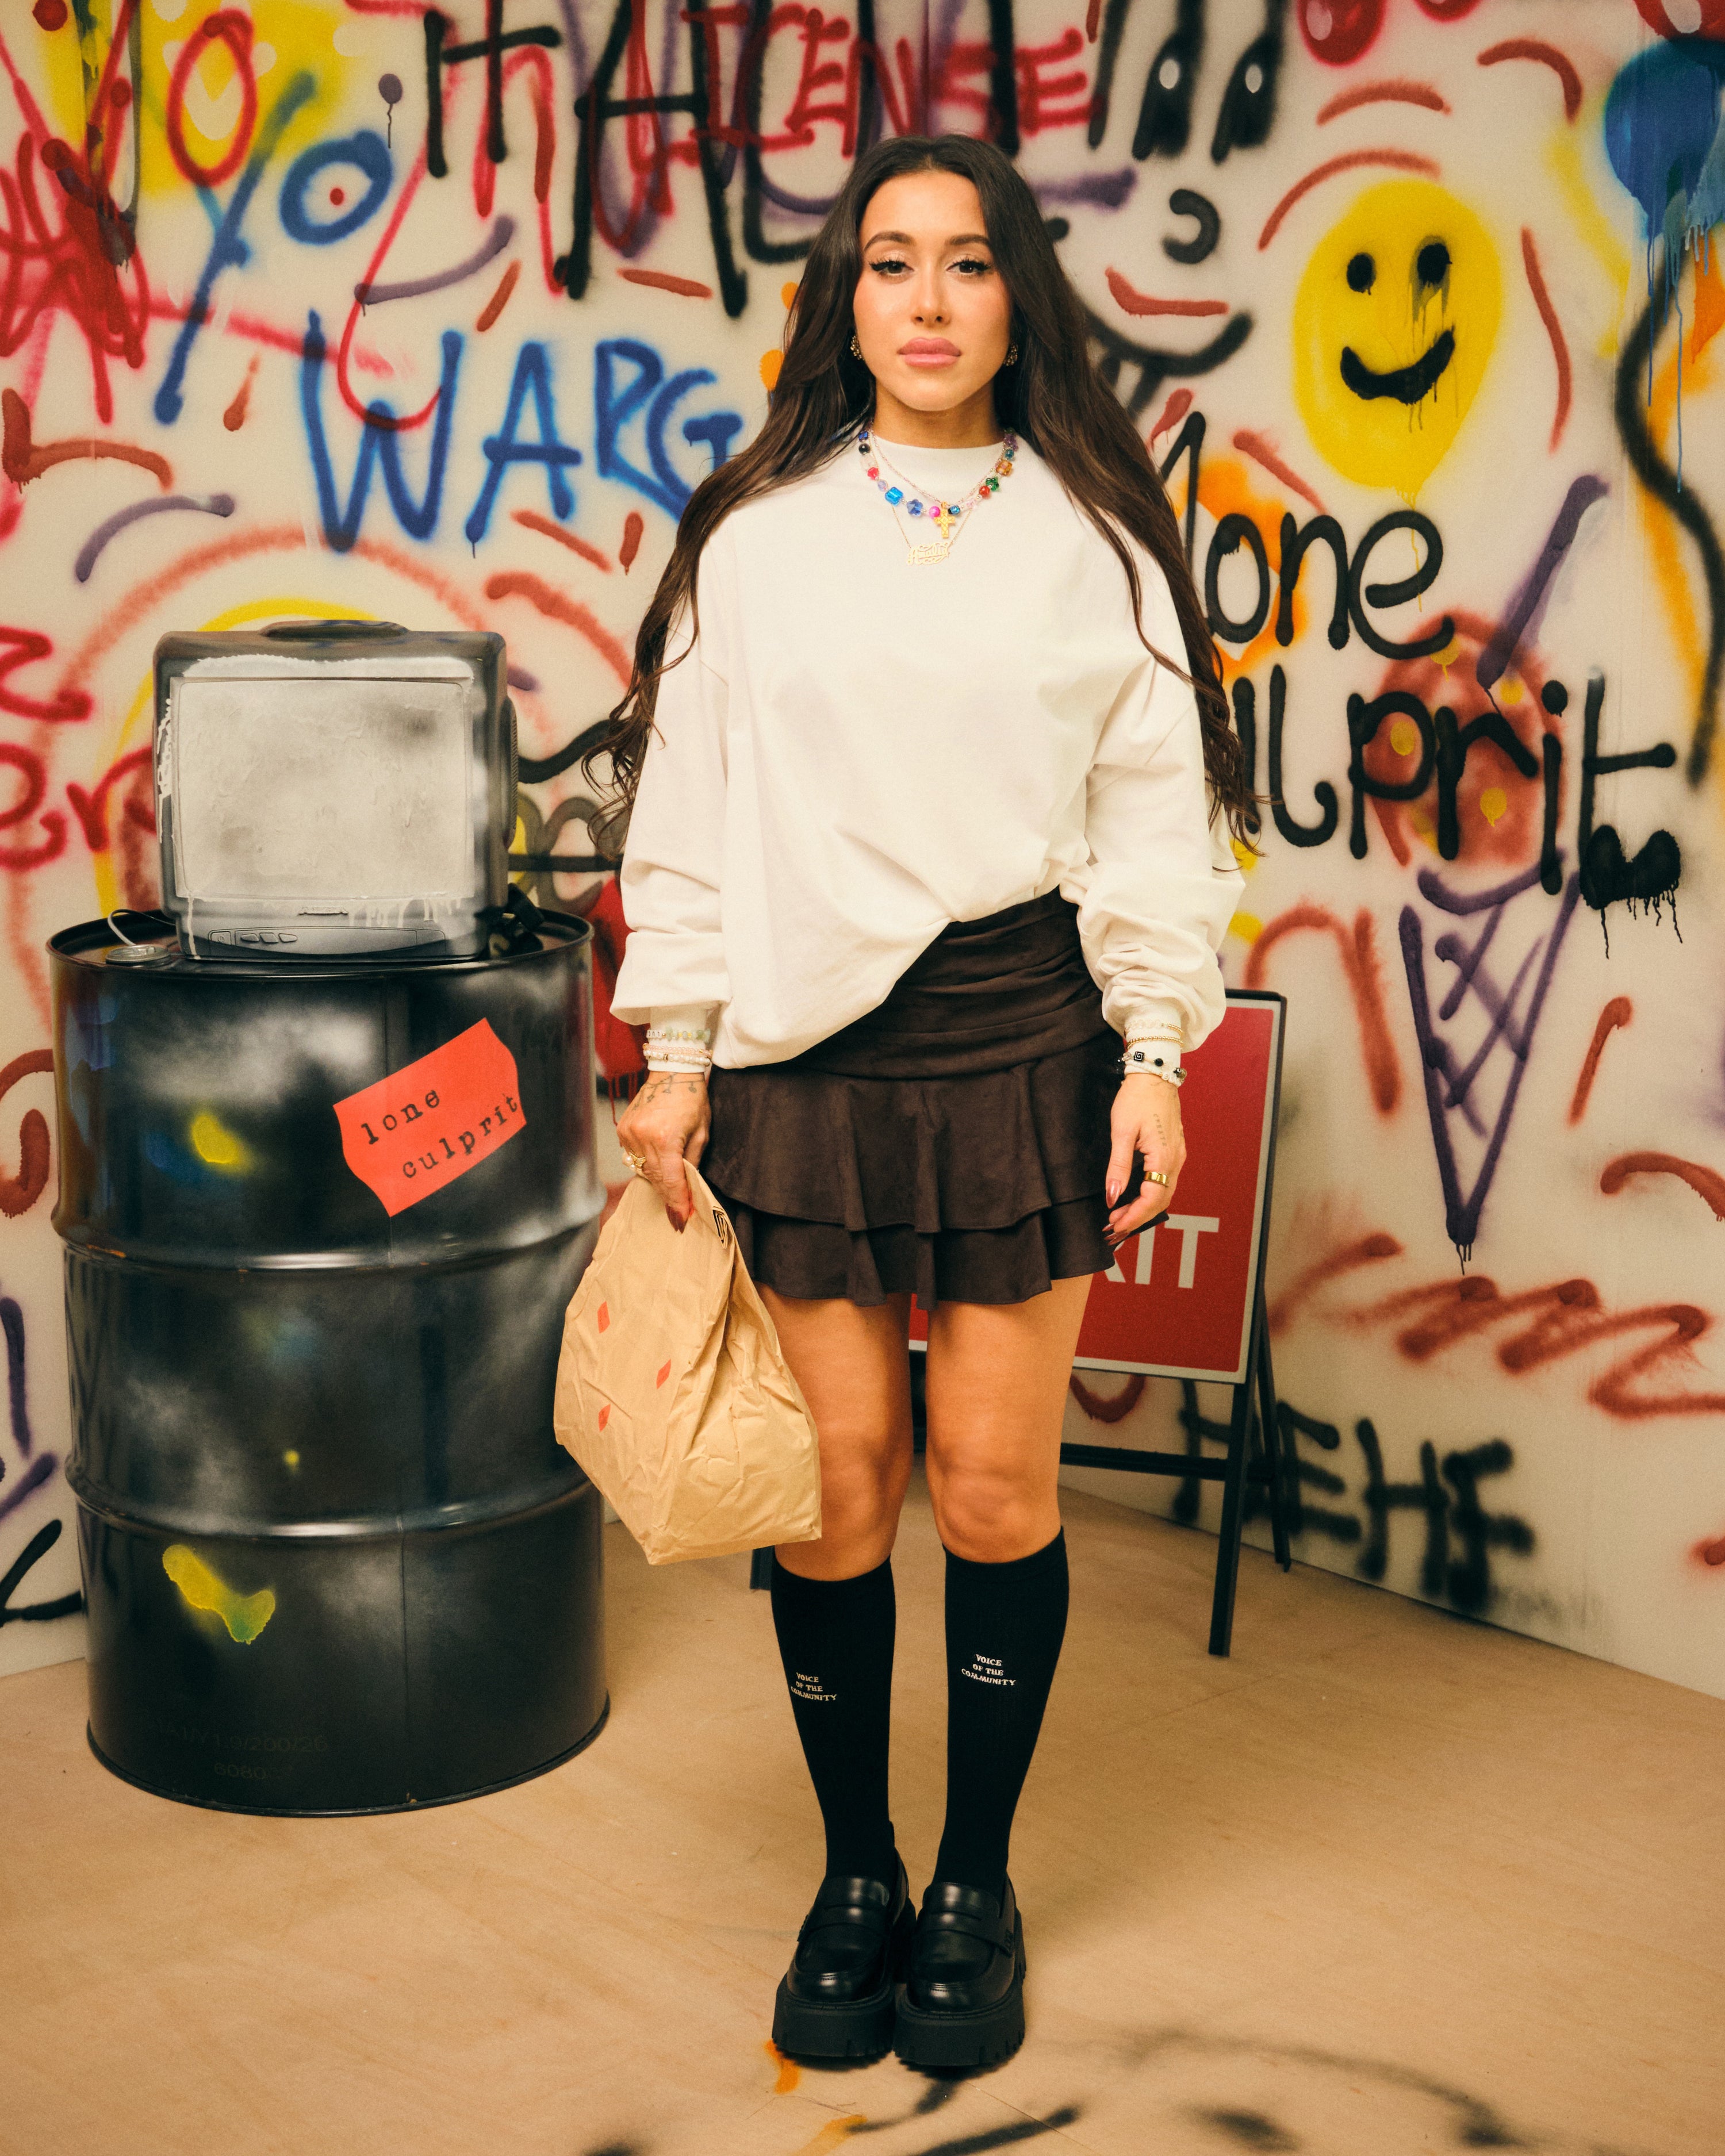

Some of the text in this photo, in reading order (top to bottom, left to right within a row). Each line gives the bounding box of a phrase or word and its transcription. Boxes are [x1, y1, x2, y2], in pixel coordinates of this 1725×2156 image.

[361, 1089, 440, 1145] lone
[402, 1094, 518, 1179] culprit
[1104, 1213, 1220, 1289] IT
[975, 1654, 1002, 1666] VOICE
[961, 1668, 1017, 1686] COMMUNITY
[972, 1663, 1004, 1676] OF THE
[796, 1672, 819, 1683] VOICE
[790, 1686, 838, 1701] COMMUNITY
[795, 1681, 823, 1692] OF THE
